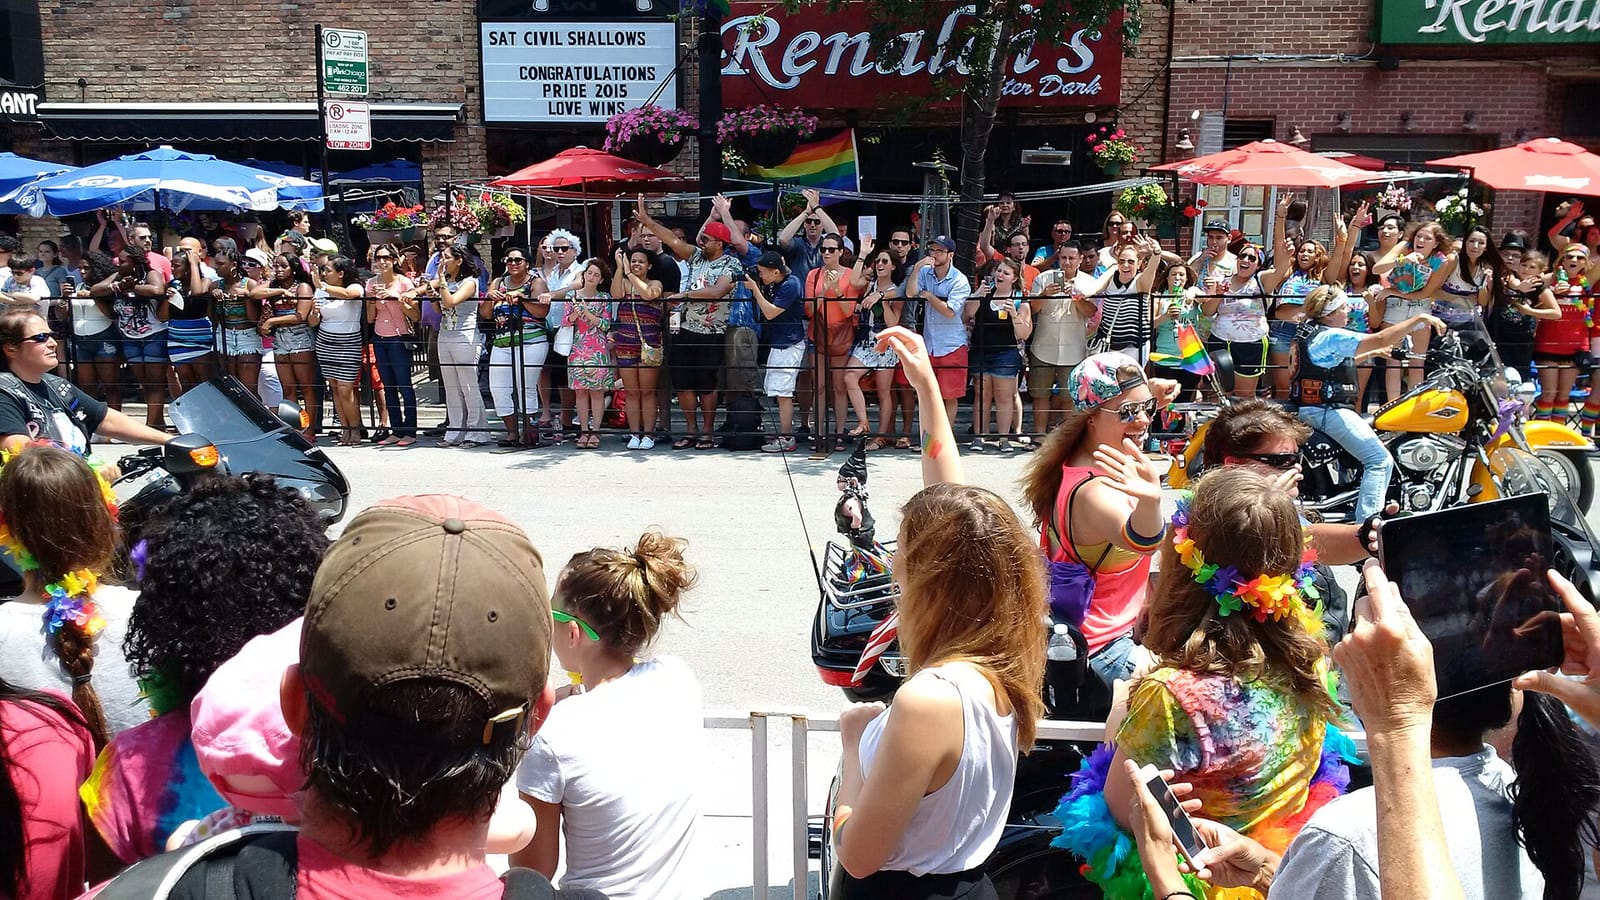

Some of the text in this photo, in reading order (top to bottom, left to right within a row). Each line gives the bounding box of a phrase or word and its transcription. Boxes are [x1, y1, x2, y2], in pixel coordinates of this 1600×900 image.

[489, 31, 646, 46] SAT CIVIL SHALLOWS
[720, 4, 1102, 90] Renaldis
[519, 66, 656, 81] CONGRATULATIONS
[542, 83, 628, 98] PRIDE 2015
[1039, 74, 1101, 96] Dark
[0, 92, 38, 115] ANT
[548, 101, 625, 116] LOVE WINS
